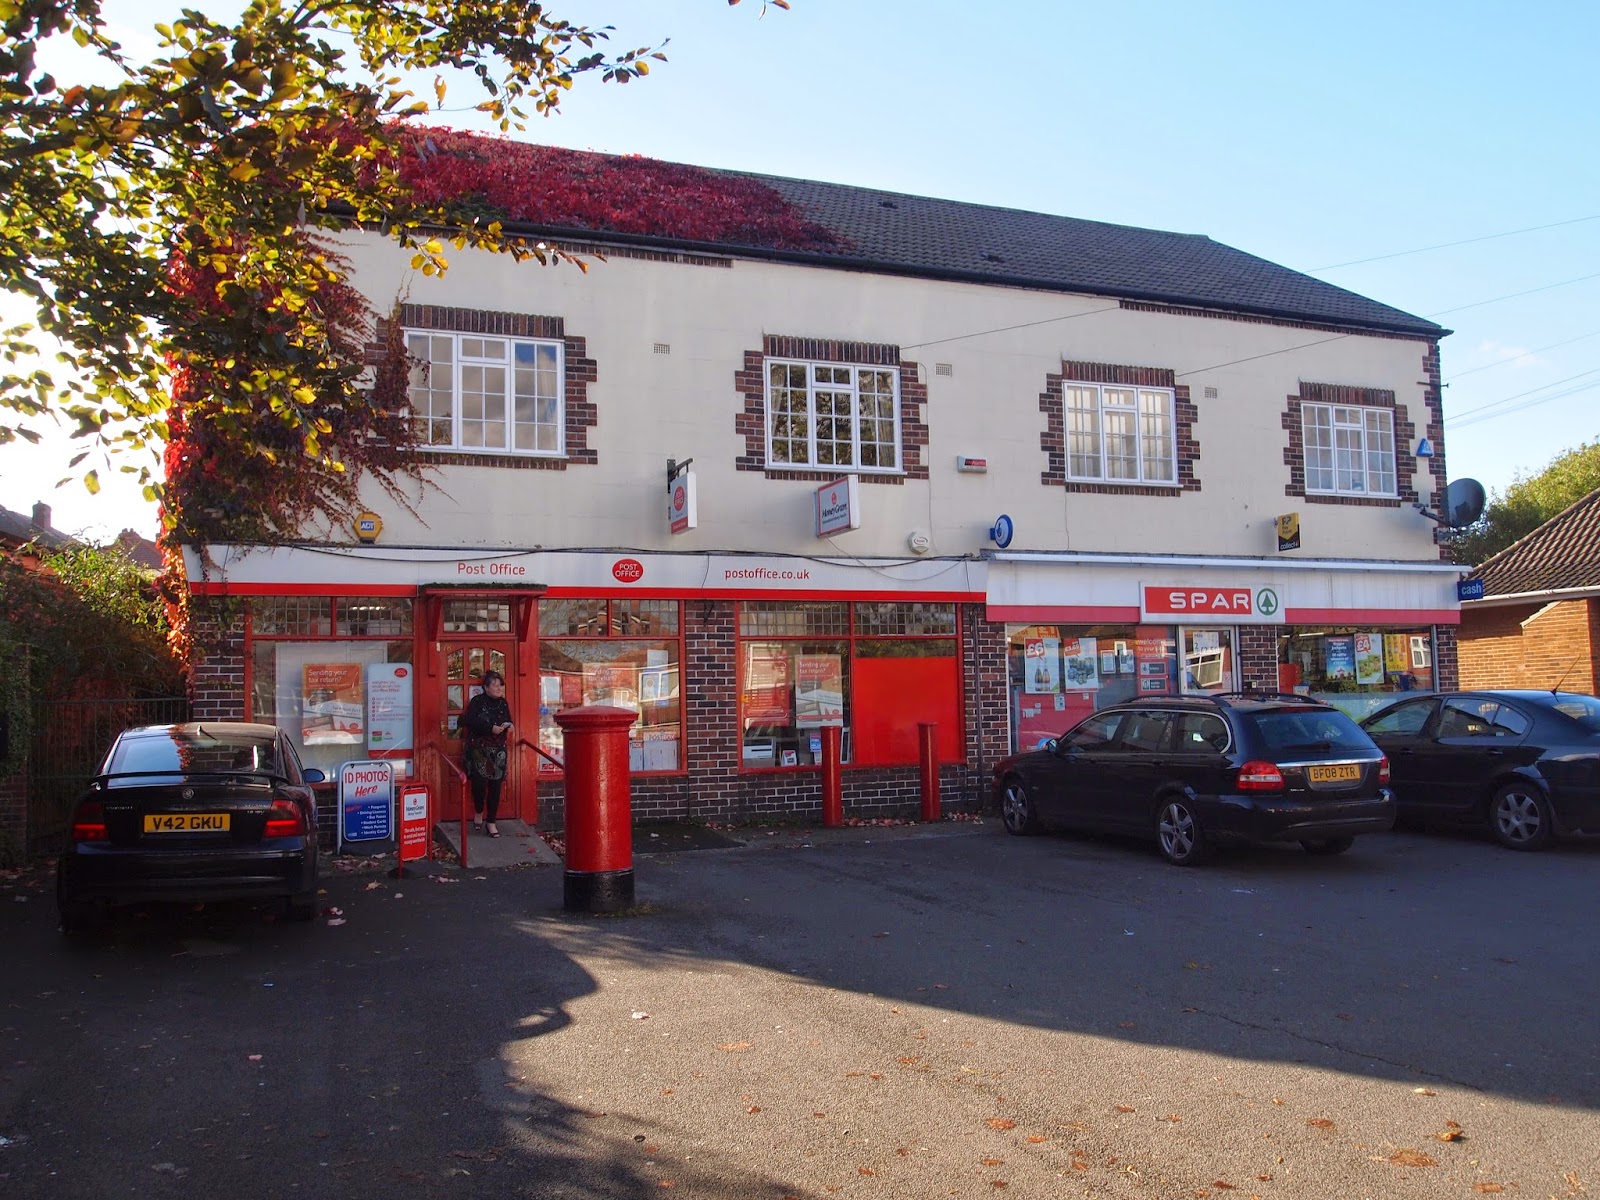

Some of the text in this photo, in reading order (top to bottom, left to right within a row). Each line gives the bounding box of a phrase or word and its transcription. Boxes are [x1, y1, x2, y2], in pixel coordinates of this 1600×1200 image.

[822, 504, 848, 518] MoneyGram
[361, 522, 374, 530] ADT
[458, 563, 526, 575] Post Office
[615, 570, 640, 578] OFFICE
[724, 568, 810, 580] postoffice.co.uk
[1461, 582, 1482, 594] cash
[1169, 592, 1249, 609] SPAR
[1026, 642, 1044, 656] £6
[1356, 640, 1370, 651] £4
[345, 771, 388, 784] ID PHOTOS
[1313, 767, 1356, 778] BF08 ZTR
[354, 785, 378, 798] Here
[152, 816, 223, 829] V42 GKU
